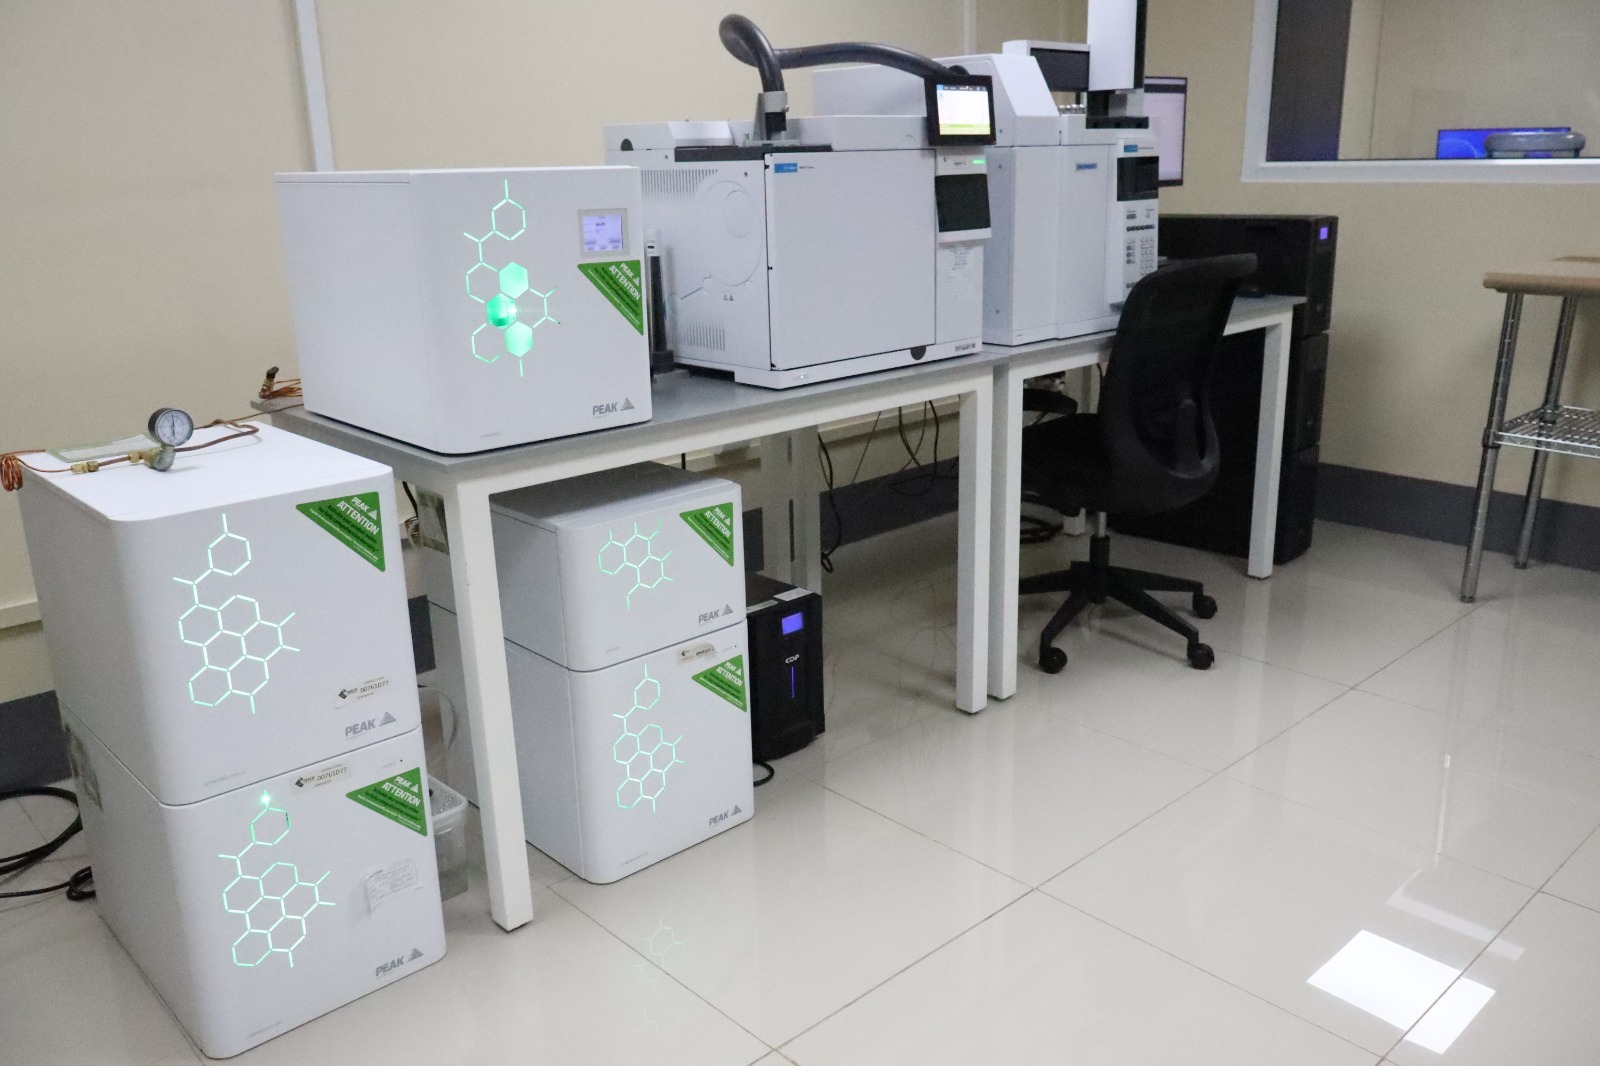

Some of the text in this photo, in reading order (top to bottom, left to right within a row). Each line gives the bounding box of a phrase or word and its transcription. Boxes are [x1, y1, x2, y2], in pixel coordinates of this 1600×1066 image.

[619, 262, 635, 278] PEAK
[608, 265, 641, 301] ATTENTION
[592, 402, 618, 416] PEAK
[351, 496, 370, 512] PEAK
[337, 501, 379, 535] ATTENTION
[714, 507, 726, 520] PEAK
[705, 510, 732, 538] ATTENTION
[698, 609, 720, 624] PEAK
[716, 666, 743, 687] ATTENTION
[345, 718, 377, 737] PEAK
[394, 776, 413, 788] PEAK
[381, 781, 421, 807] ATTENTION
[709, 809, 730, 826] PEAK
[375, 955, 405, 977] PEAK
